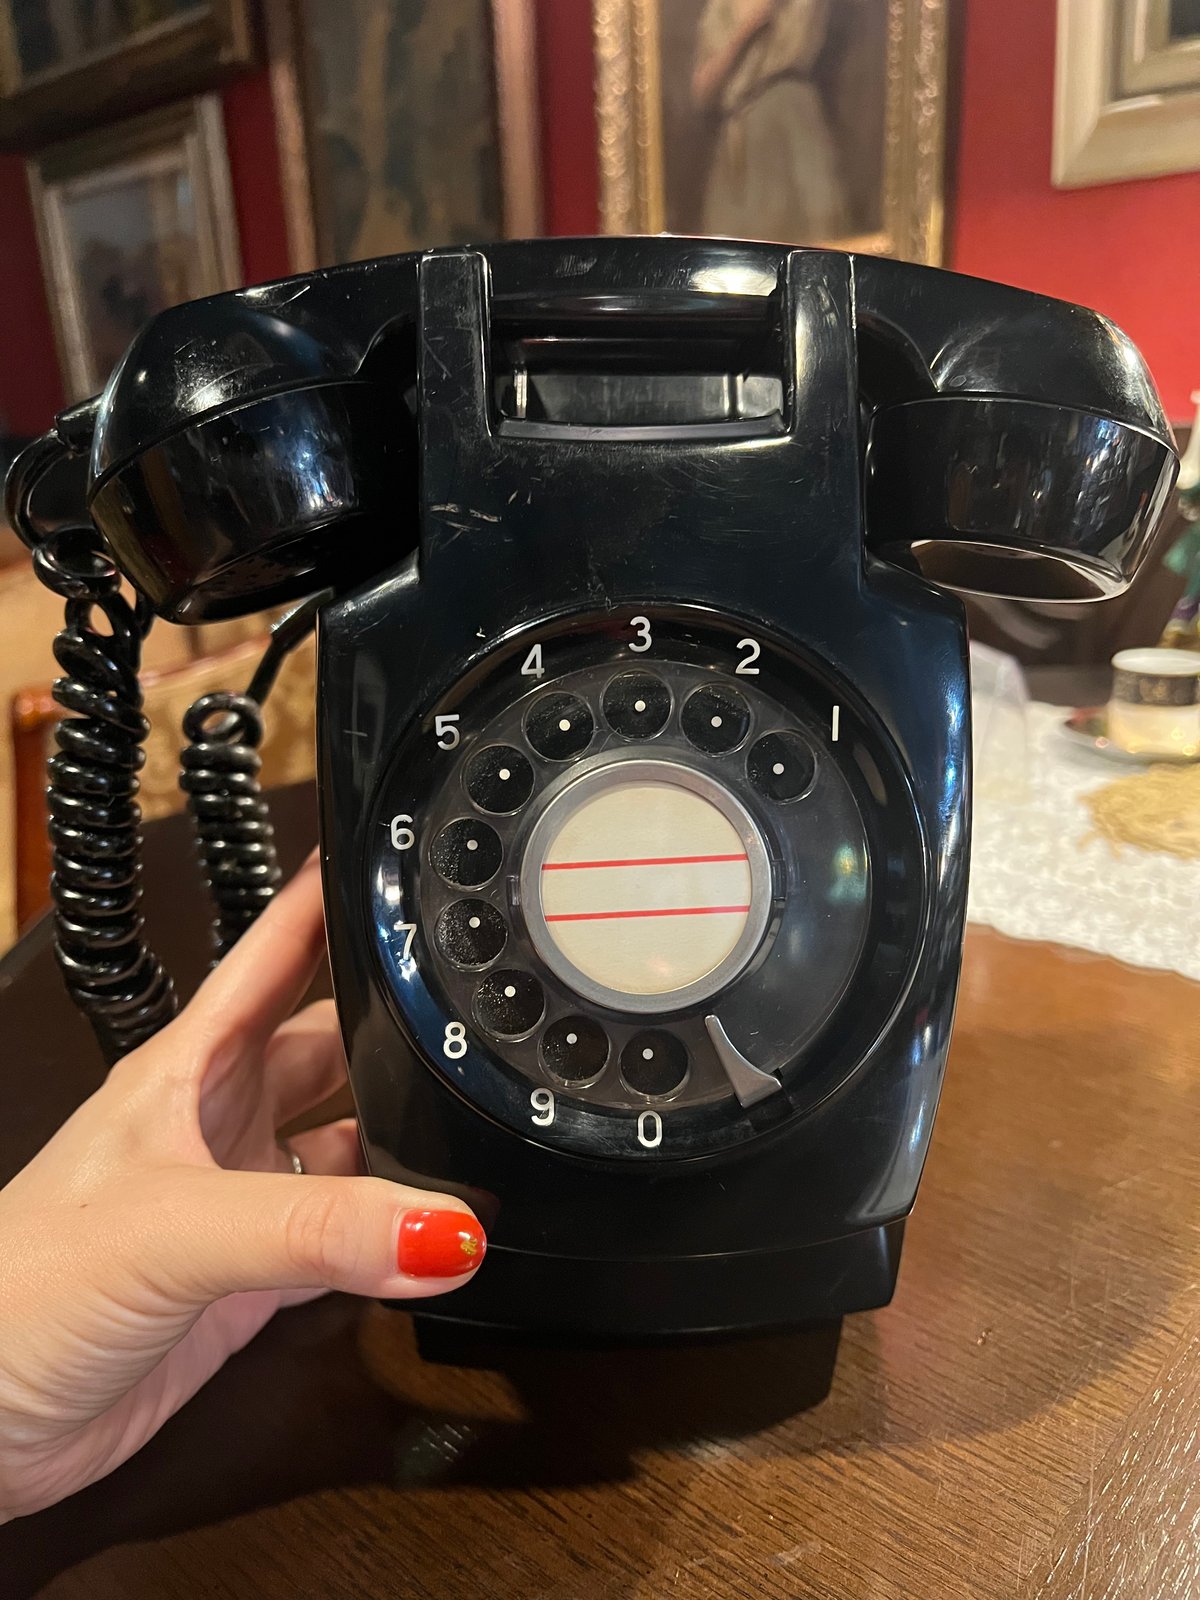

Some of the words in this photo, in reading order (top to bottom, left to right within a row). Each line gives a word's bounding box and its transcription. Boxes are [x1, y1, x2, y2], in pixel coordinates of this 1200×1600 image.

[628, 616, 652, 652] 3
[520, 643, 545, 679] 4
[735, 638, 761, 675] 2
[435, 714, 460, 750] 5
[831, 705, 840, 742] 1
[390, 814, 415, 851] 6
[393, 923, 417, 961] 7
[442, 1021, 468, 1060] 8
[530, 1088, 555, 1127] 9
[637, 1110, 663, 1148] 0
